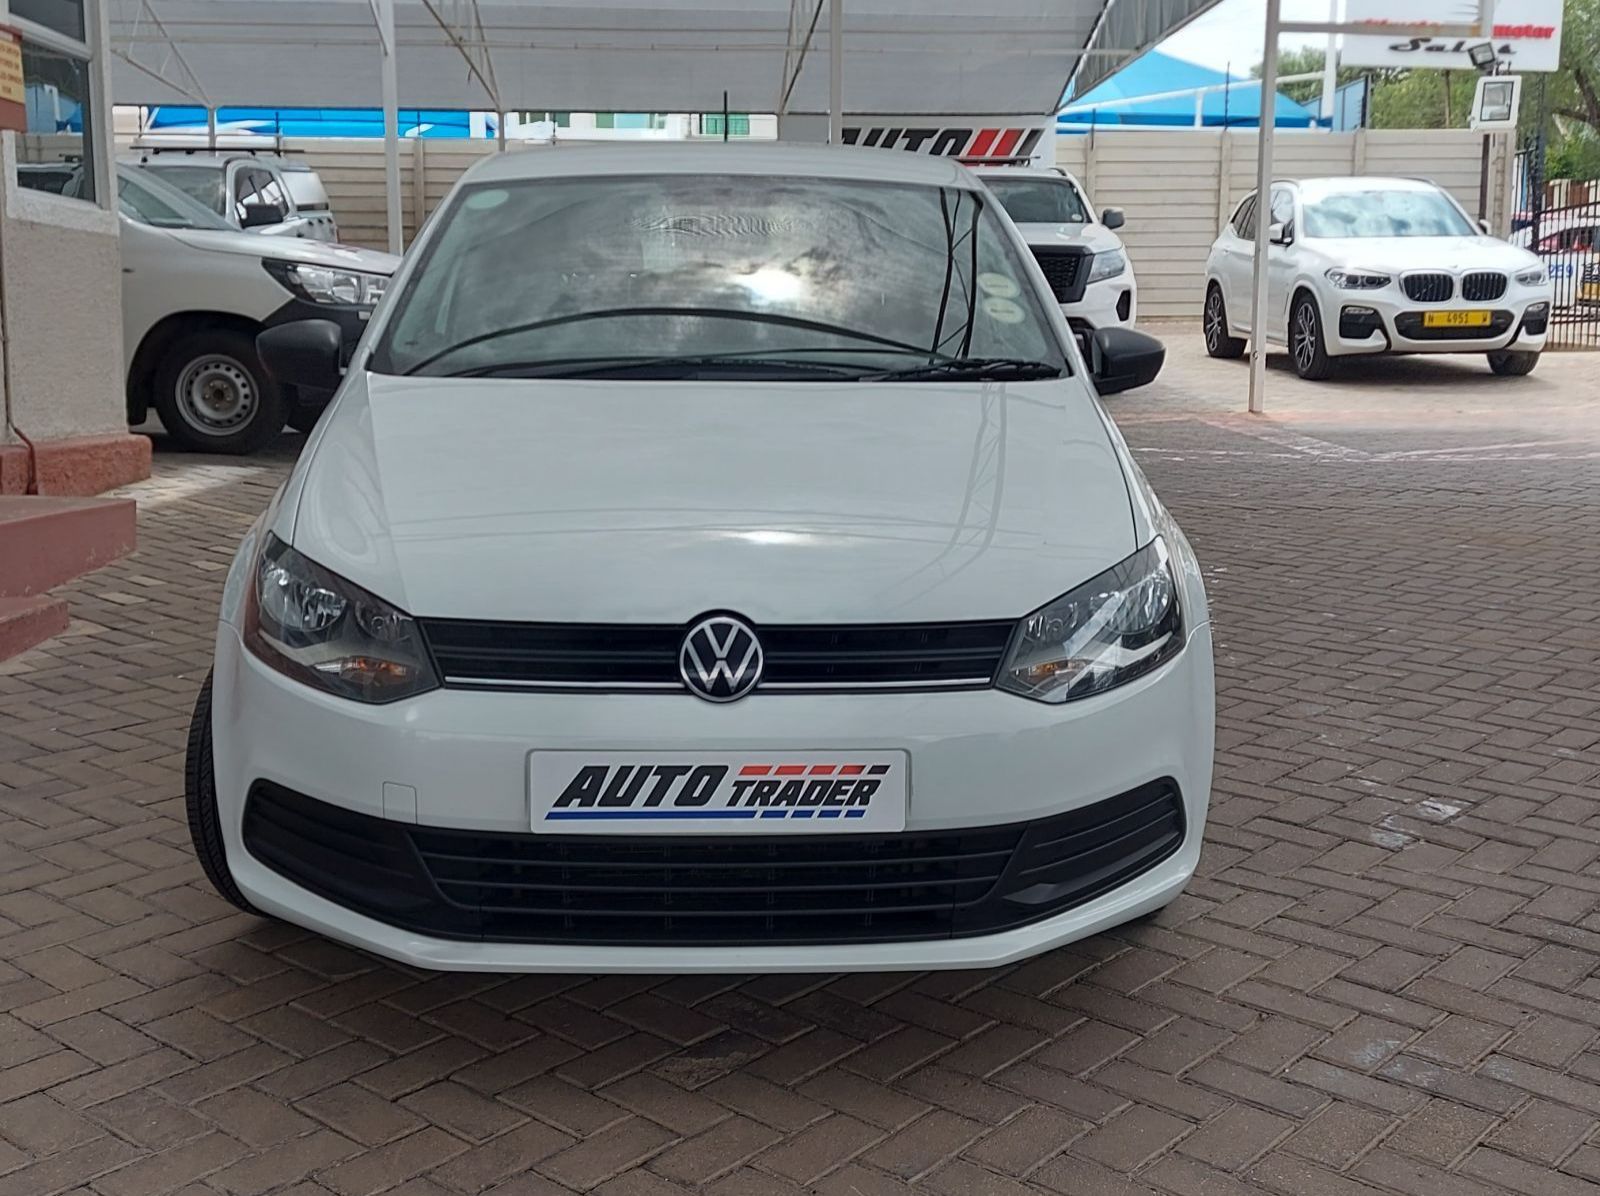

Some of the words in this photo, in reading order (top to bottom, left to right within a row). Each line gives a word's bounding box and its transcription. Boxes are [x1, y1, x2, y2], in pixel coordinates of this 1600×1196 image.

[1388, 37, 1517, 55] Sals
[552, 765, 729, 808] AUTO
[726, 779, 882, 808] TRADER
